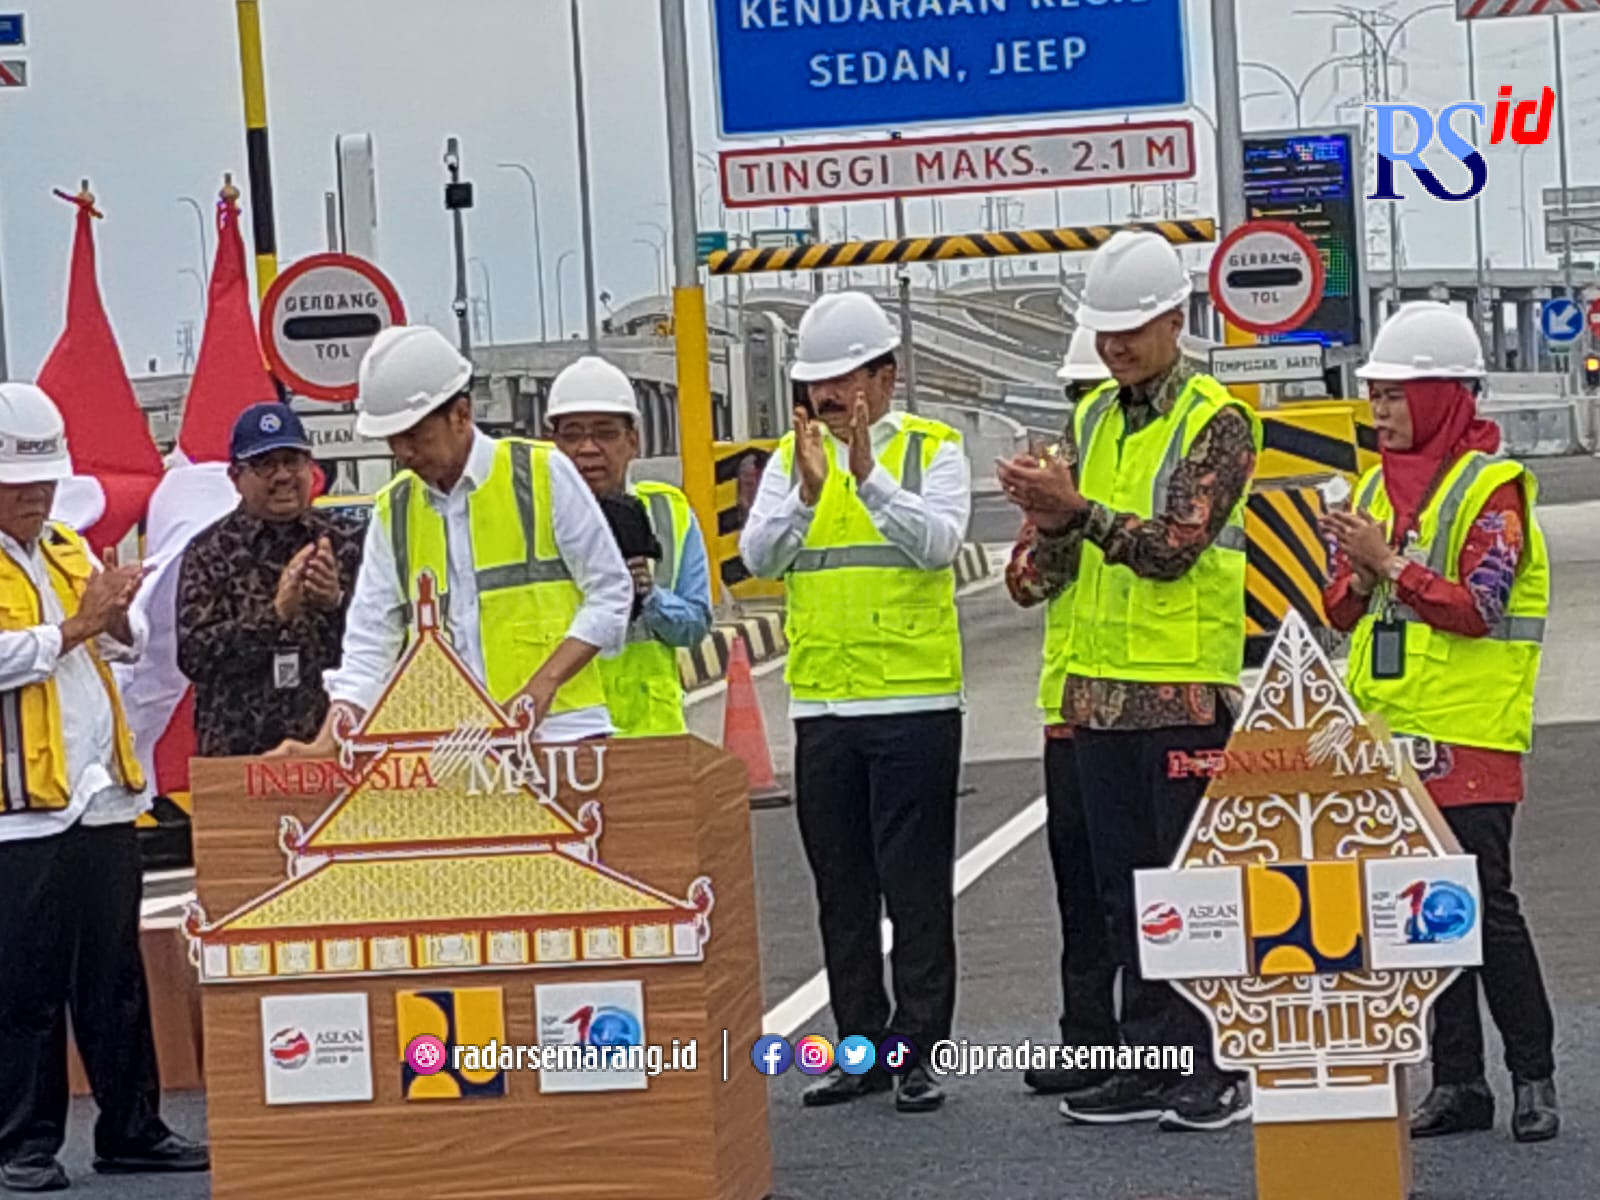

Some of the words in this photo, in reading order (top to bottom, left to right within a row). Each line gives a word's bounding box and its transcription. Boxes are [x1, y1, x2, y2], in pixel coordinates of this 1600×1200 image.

[809, 47, 967, 88] SEDAN,
[989, 36, 1087, 75] JEEP
[739, 153, 889, 194] TINGGI
[915, 144, 1049, 184] MAKS.
[1071, 139, 1126, 173] 2.1
[1146, 135, 1177, 168] M
[1228, 252, 1303, 267] GERBANG
[284, 292, 379, 312] GERBANG
[1250, 291, 1281, 304] TOL
[315, 343, 352, 360] TOL
[466, 745, 608, 804] MAJU
[1333, 736, 1438, 782] MAJU
